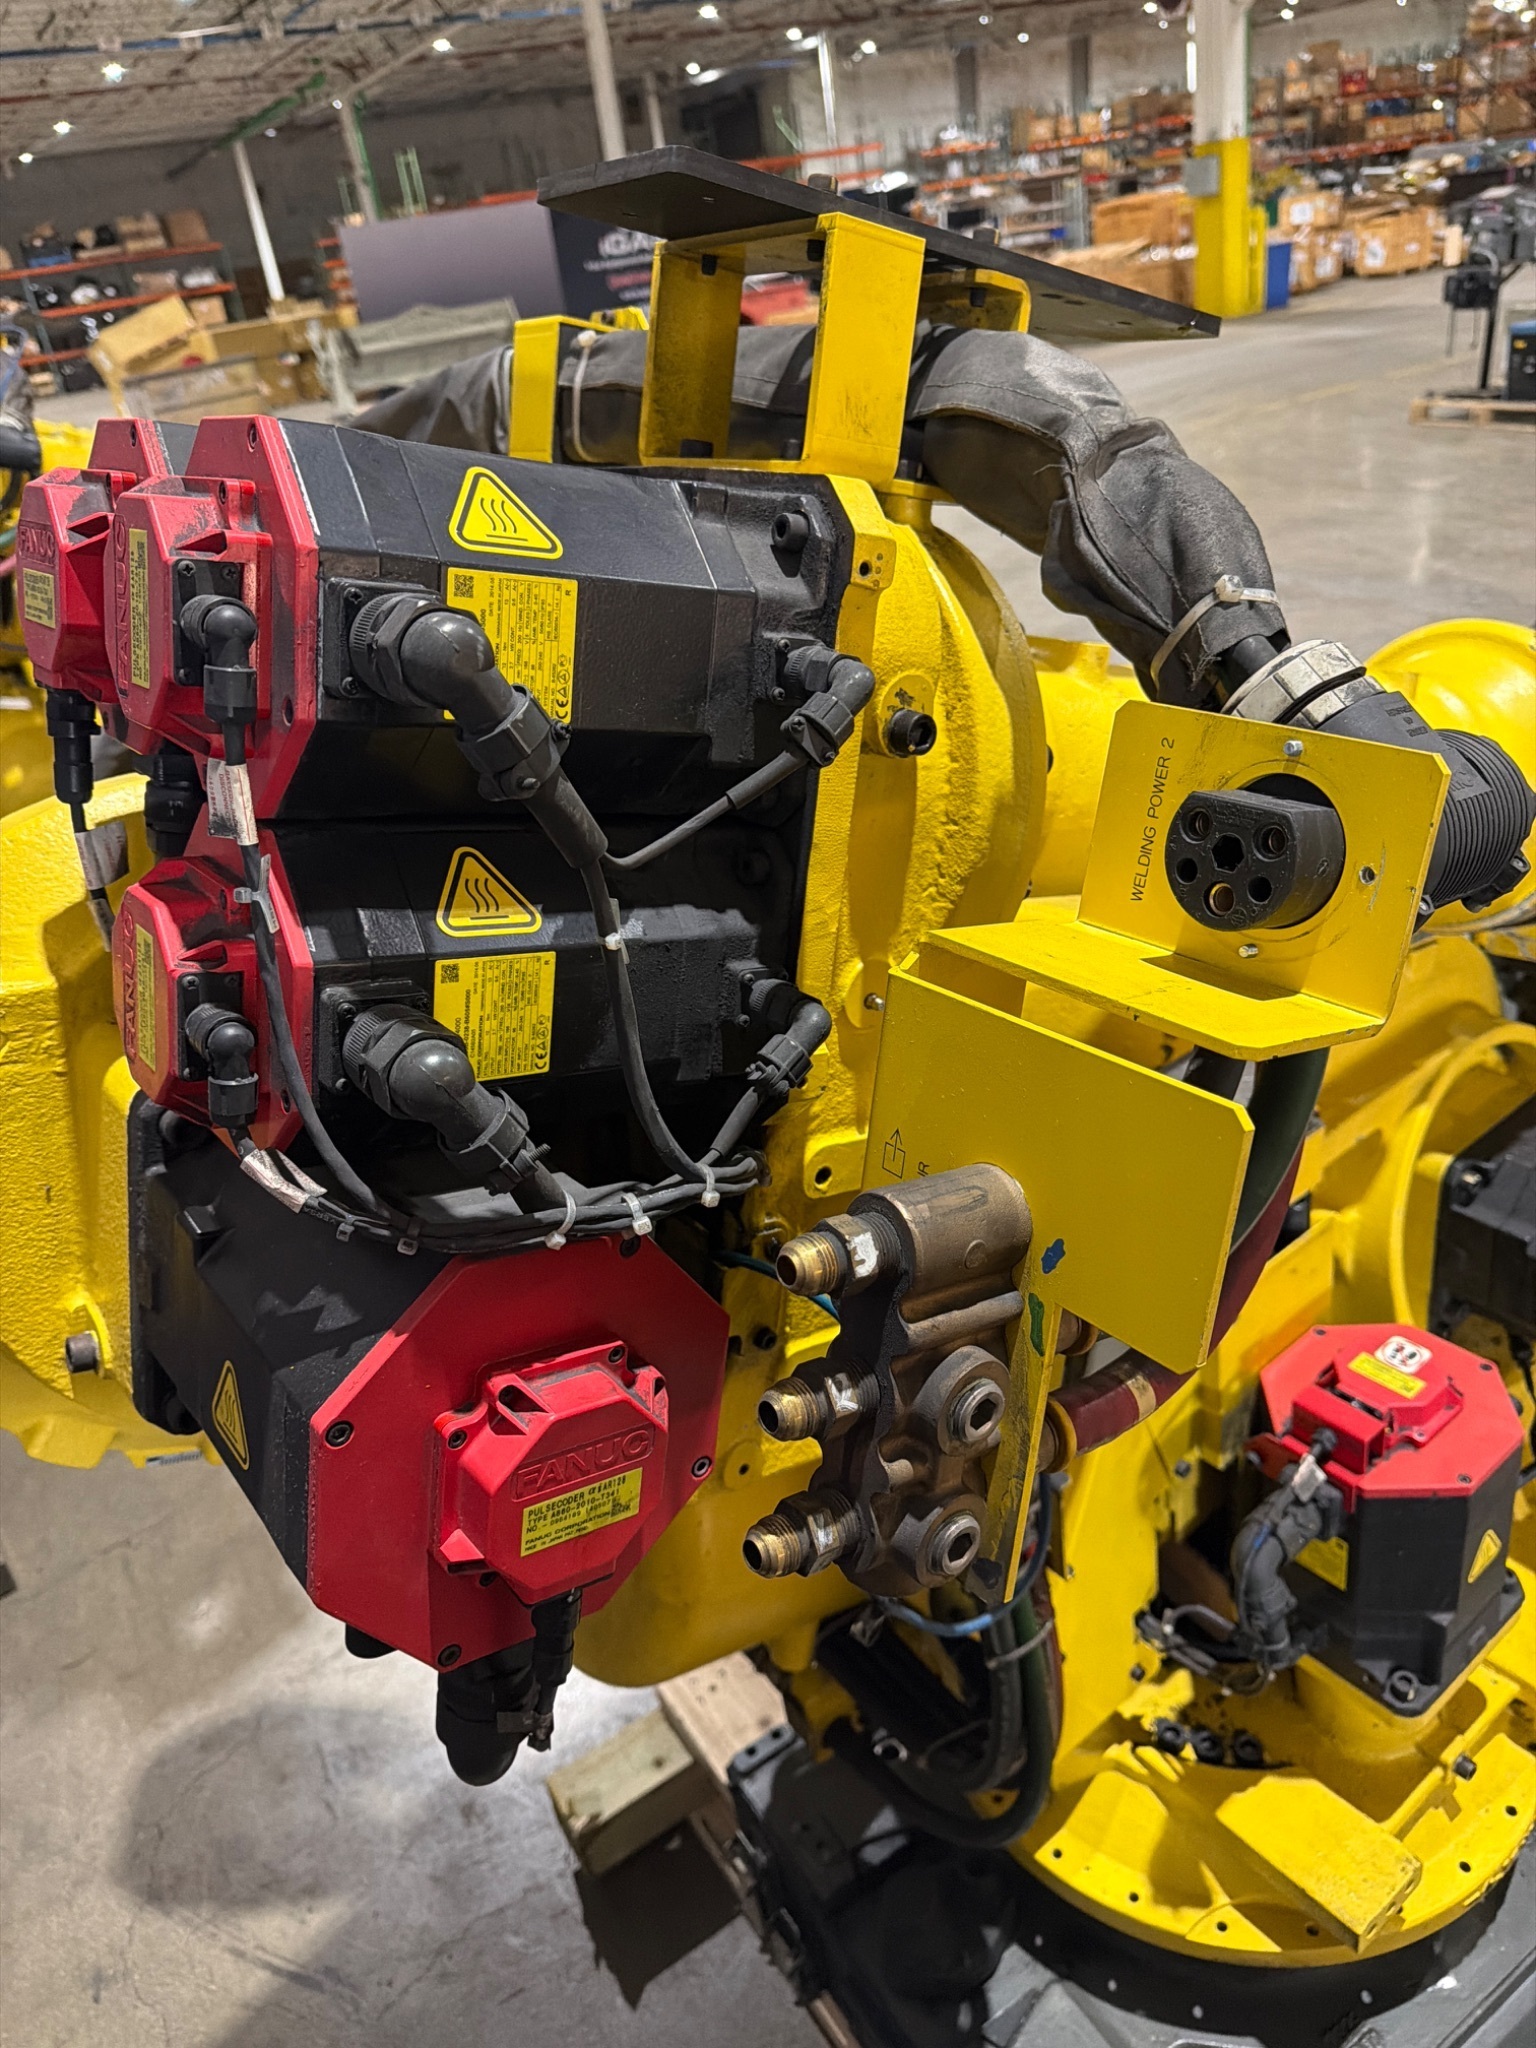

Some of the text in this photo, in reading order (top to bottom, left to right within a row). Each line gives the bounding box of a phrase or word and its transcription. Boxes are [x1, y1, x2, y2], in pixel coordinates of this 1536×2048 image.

[19, 525, 55, 559] FANUC
[114, 520, 129, 690] FANUC
[1130, 737, 1175, 902] WELDING POWER 2
[122, 910, 137, 1062] FANUC
[516, 1430, 650, 1498] FANUC
[524, 1509, 610, 1545] FANUC CORPORATION
[527, 1490, 585, 1519] PULSECODER
[527, 1513, 547, 1527] TYPE
